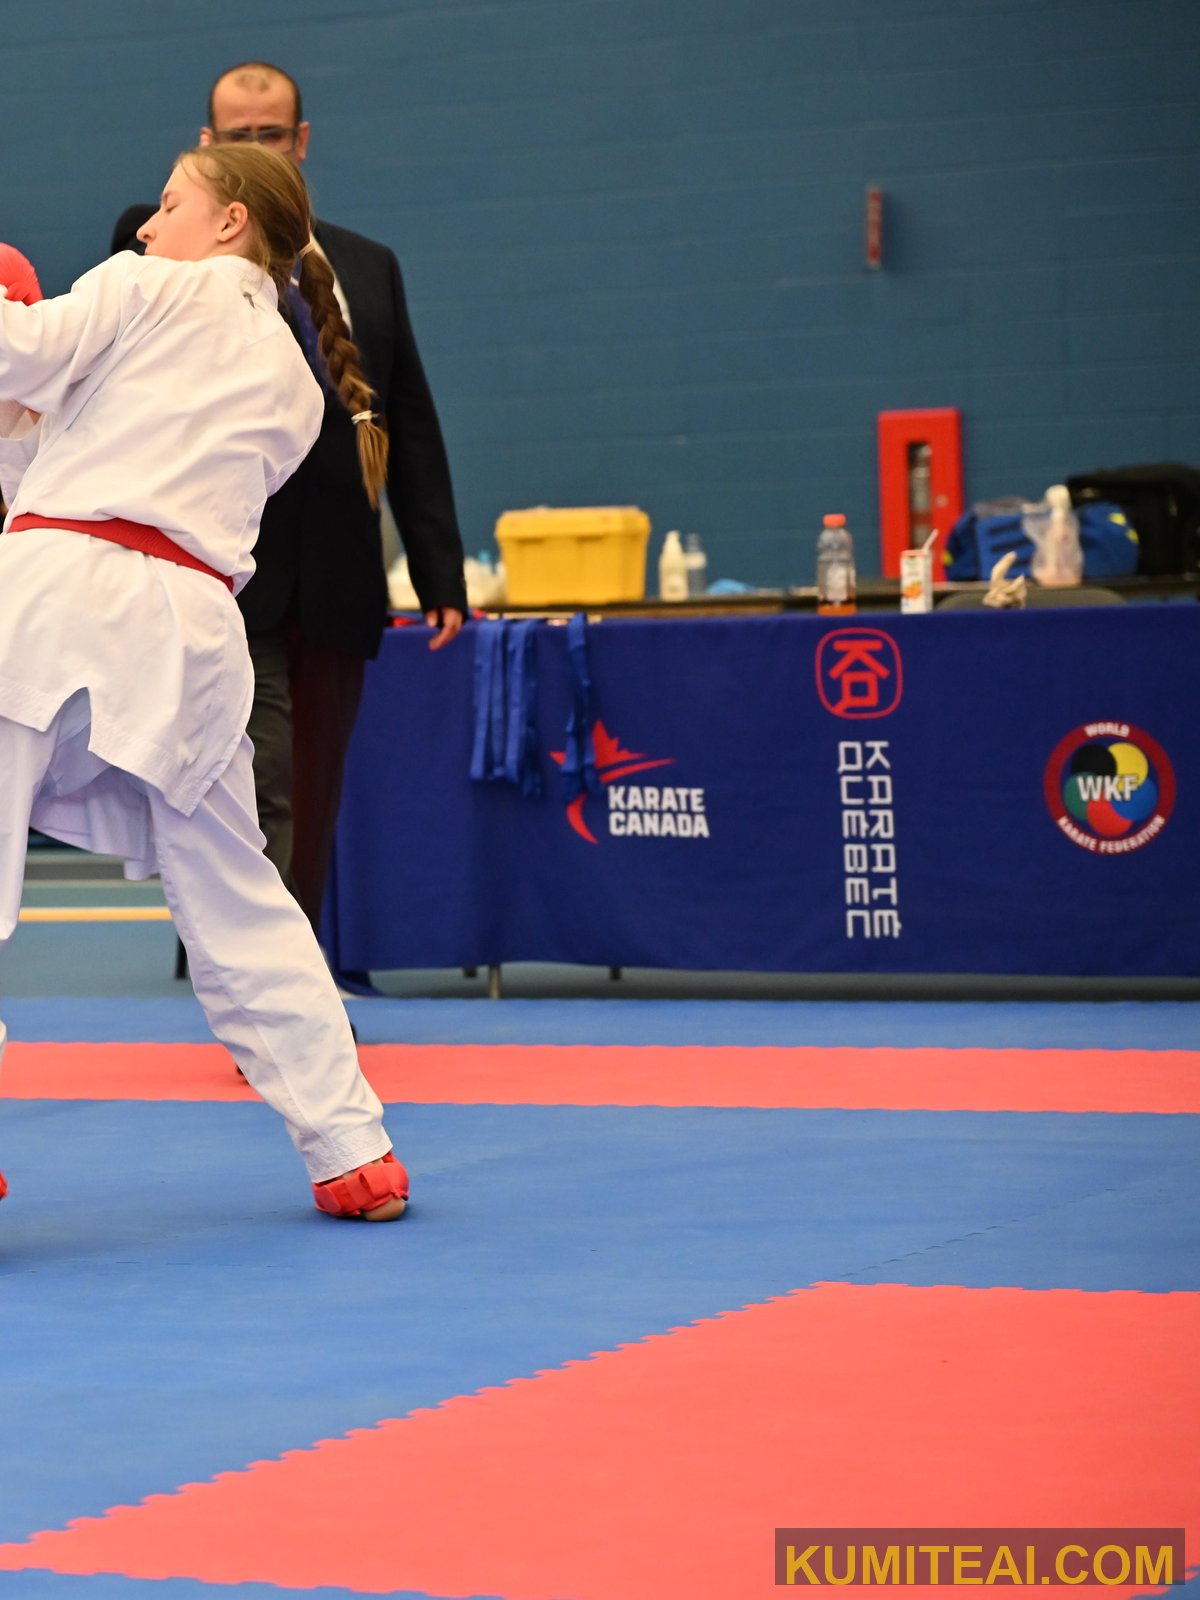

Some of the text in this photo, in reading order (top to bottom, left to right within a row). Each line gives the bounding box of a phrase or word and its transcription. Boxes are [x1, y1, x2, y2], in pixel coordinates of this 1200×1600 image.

[1084, 722, 1130, 737] WORLD
[608, 785, 706, 813] KARATE
[1077, 775, 1140, 801] WKF
[608, 811, 710, 838] CANADA
[1057, 814, 1166, 853] KARATE FEDERATION
[837, 740, 871, 940] QUÉBEC
[864, 740, 902, 939] KARATÉ
